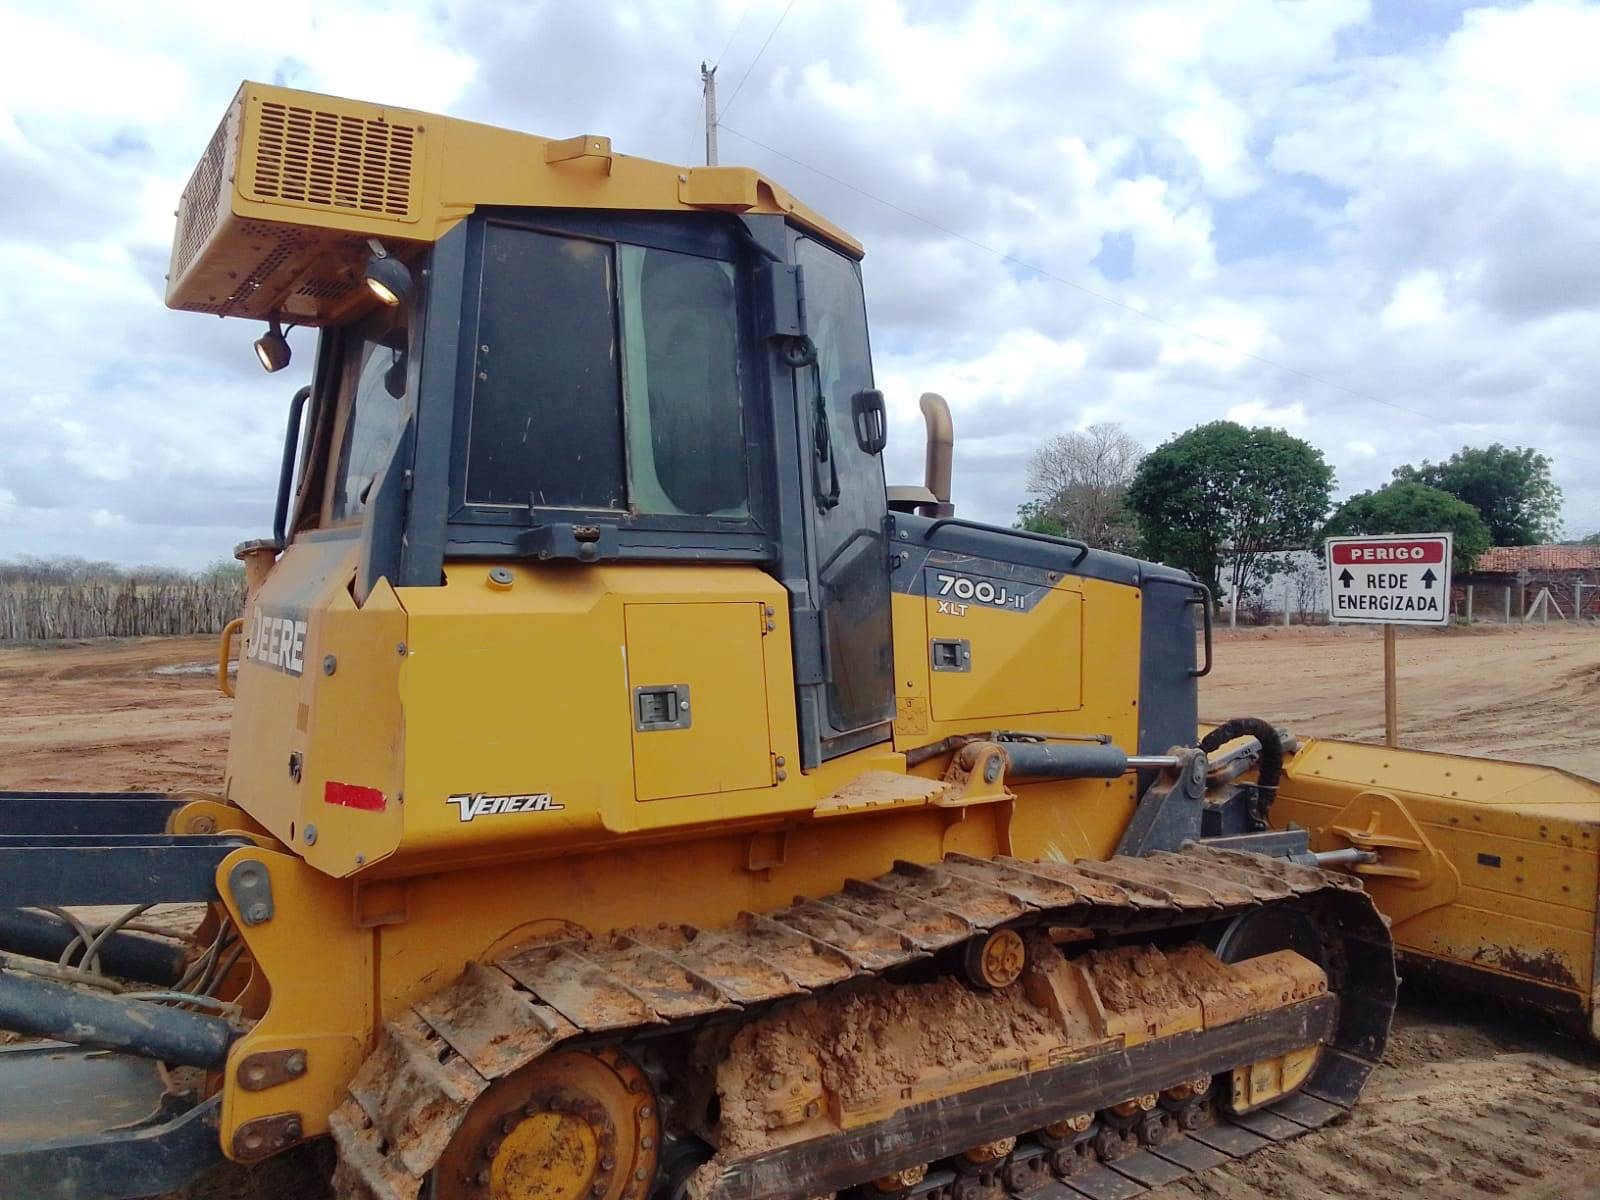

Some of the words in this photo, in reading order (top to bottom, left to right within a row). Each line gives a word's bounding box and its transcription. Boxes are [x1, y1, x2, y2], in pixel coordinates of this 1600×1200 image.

[1351, 547, 1424, 560] PERIGO
[1367, 574, 1408, 589] REDE
[938, 601, 968, 616] XLT
[1338, 595, 1438, 611] ENERGIZADA
